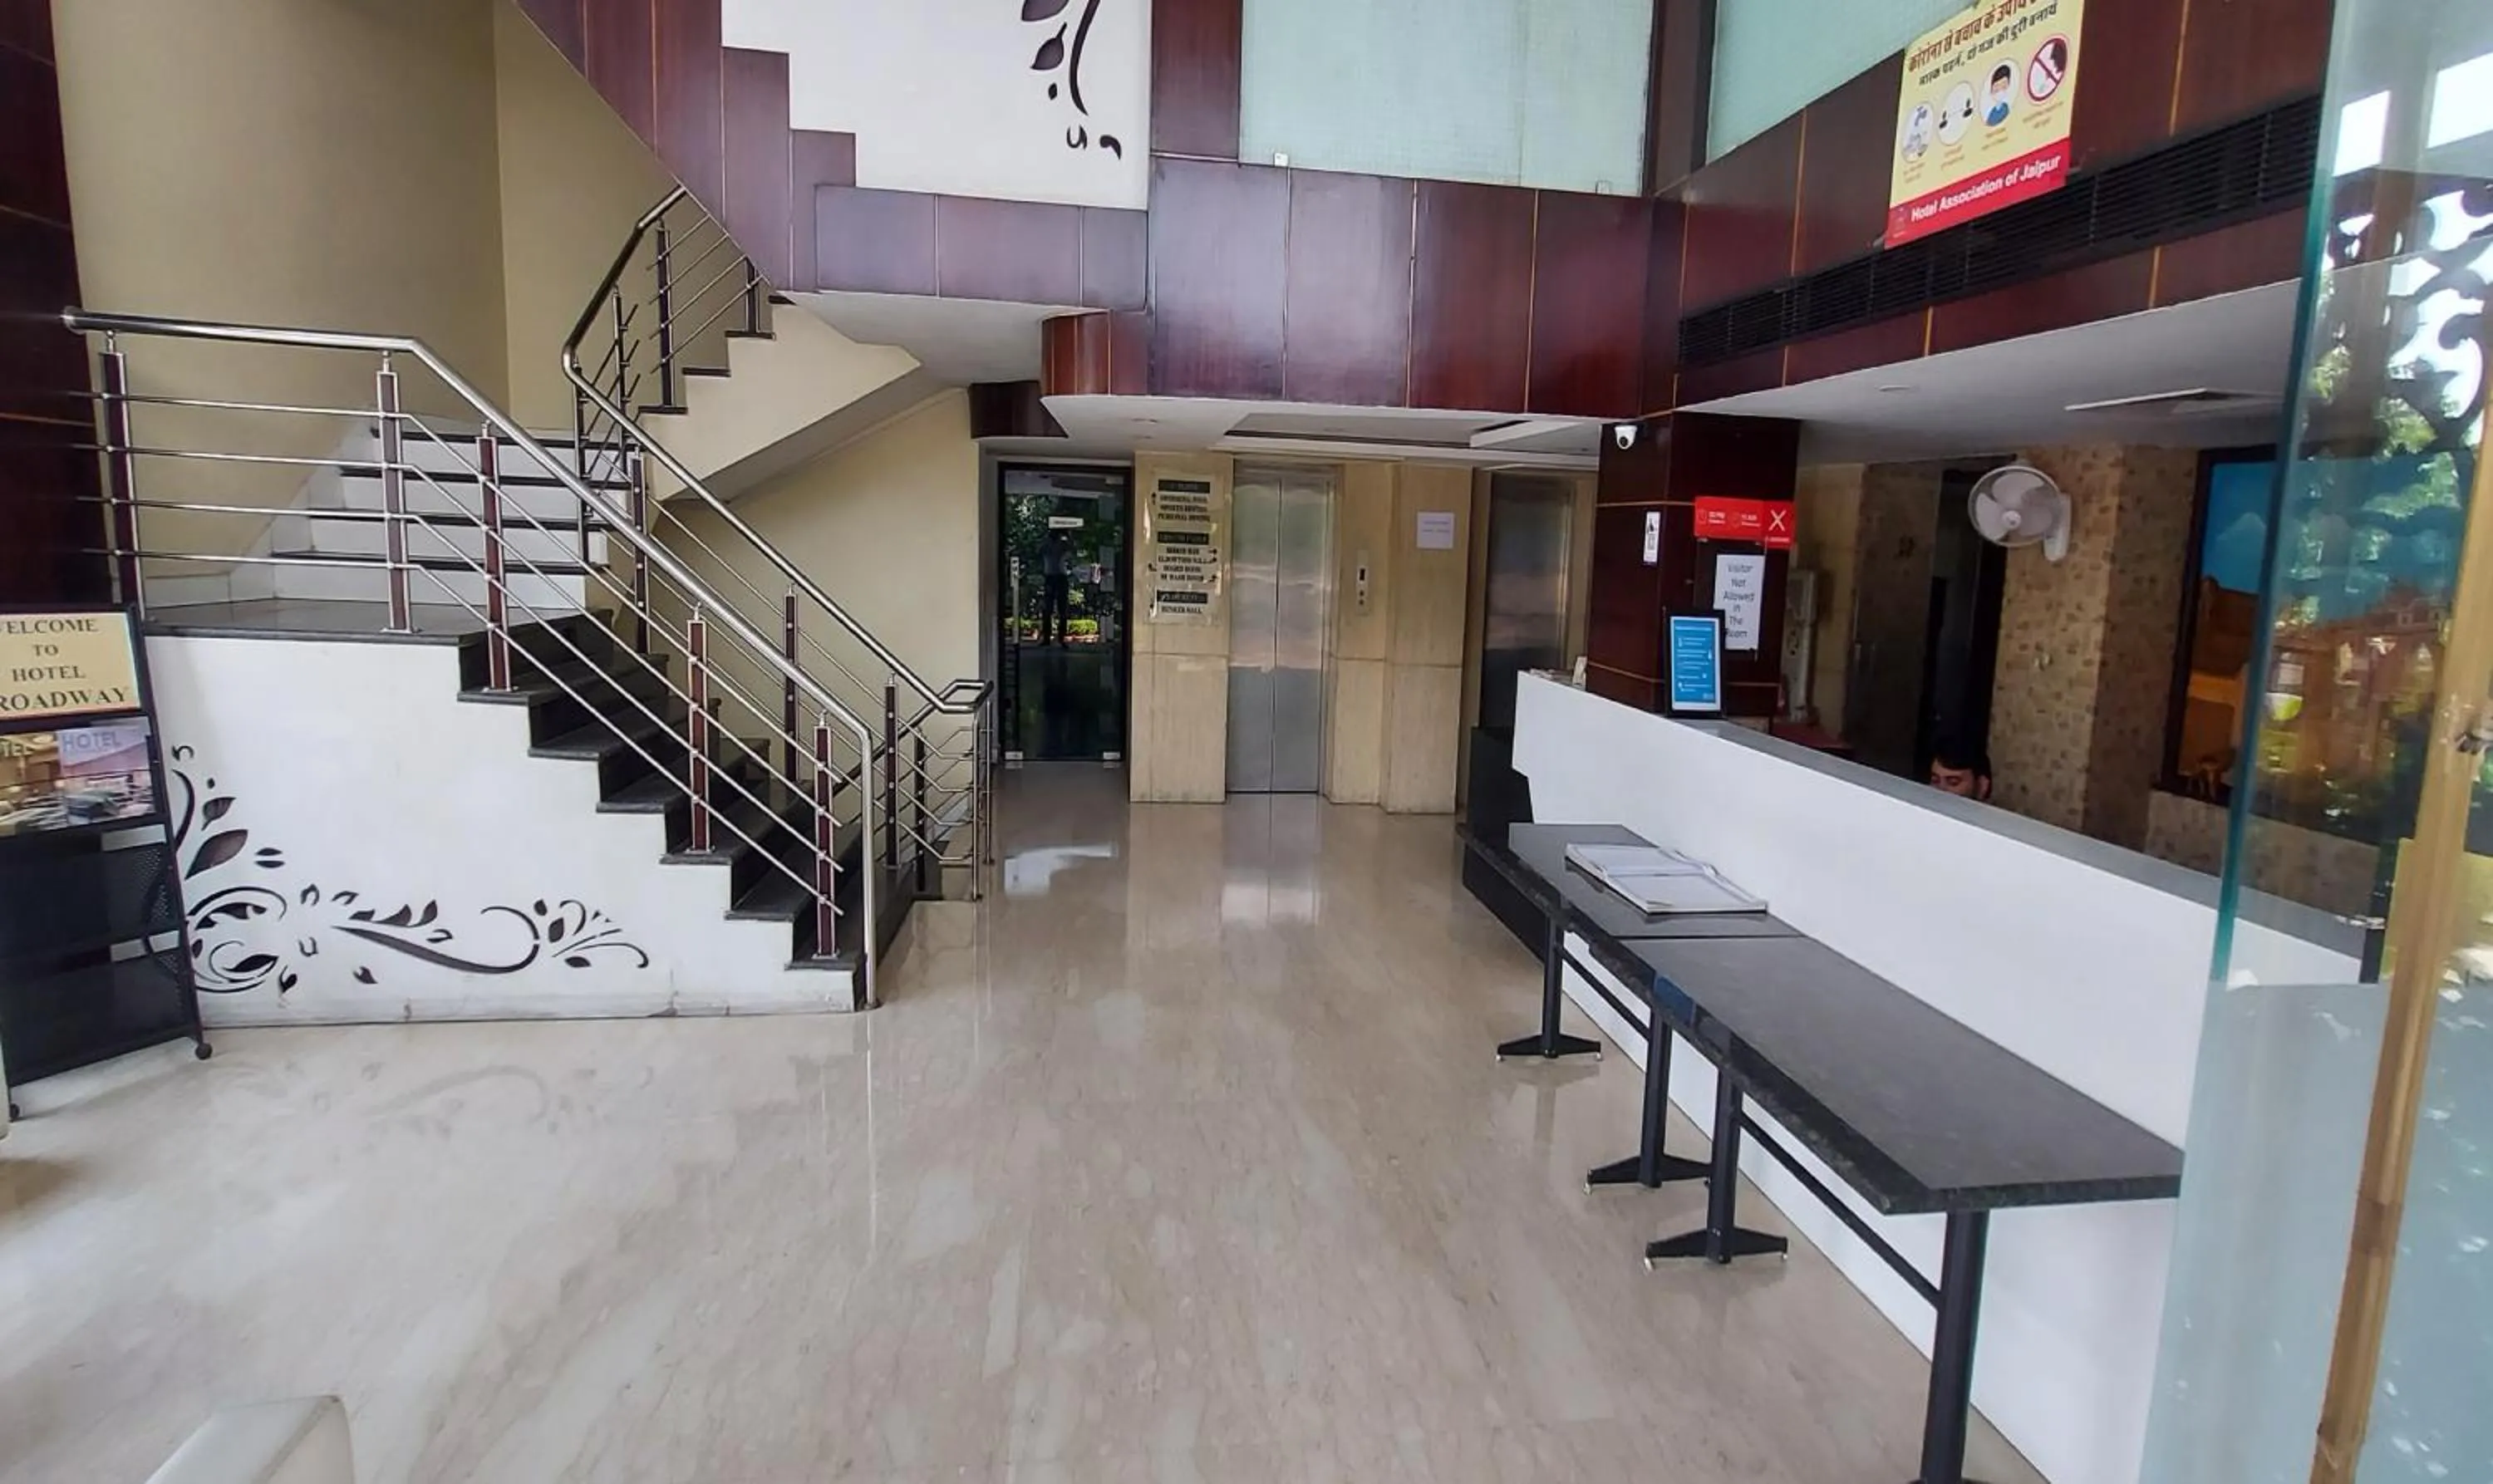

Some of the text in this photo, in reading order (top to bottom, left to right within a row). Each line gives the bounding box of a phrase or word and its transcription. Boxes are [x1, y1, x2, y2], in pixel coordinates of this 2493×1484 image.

[1910, 155, 2062, 222] Hotel Association of Jaipur
[0, 618, 98, 635] ELCOME
[33, 643, 59, 656] TO
[12, 665, 86, 682] HOTEL
[61, 731, 122, 751] HOTEL
